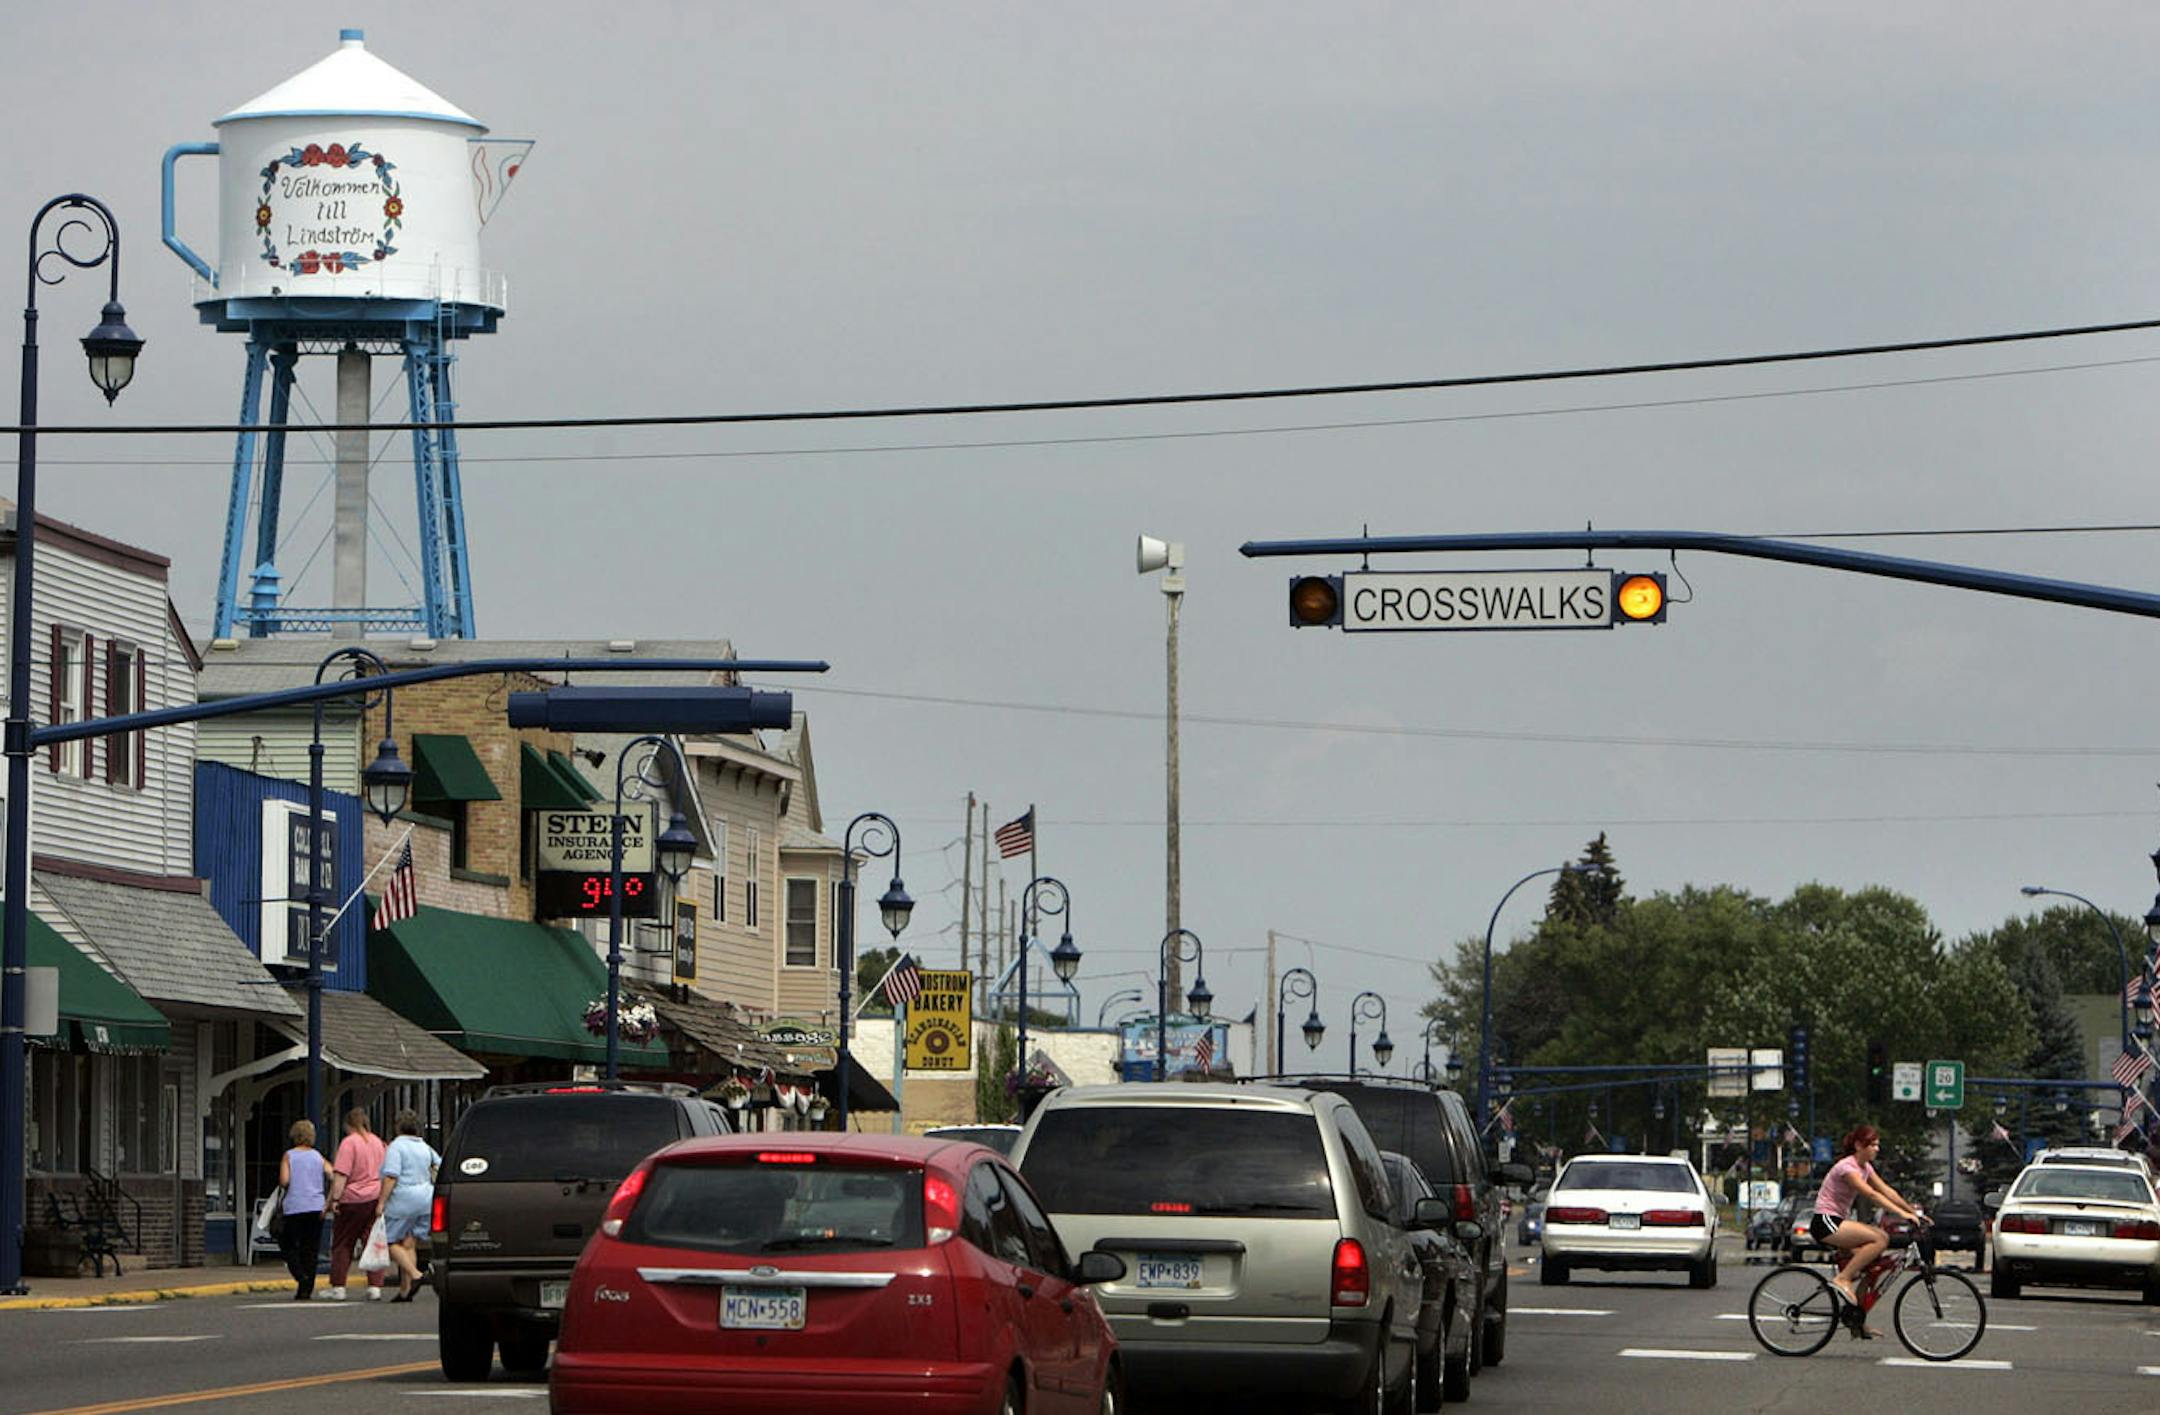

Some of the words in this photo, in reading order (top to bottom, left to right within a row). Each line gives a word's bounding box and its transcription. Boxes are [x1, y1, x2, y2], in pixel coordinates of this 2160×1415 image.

[317, 200, 347, 220] till
[287, 225, 374, 246] Lindström
[1354, 585, 1605, 622] CROSSWALKS
[547, 814, 644, 834] STEN
[548, 836, 644, 848] INSURACE
[920, 973, 968, 993] NDSTROM
[914, 994, 963, 1012] BAKERY
[759, 1031, 832, 1045] assage
[1938, 1073, 1952, 1084] 20
[1140, 1263, 1166, 1280] EWP
[1173, 1263, 1199, 1280] 839
[726, 1298, 759, 1319] MCN
[768, 1299, 799, 1321] 558
